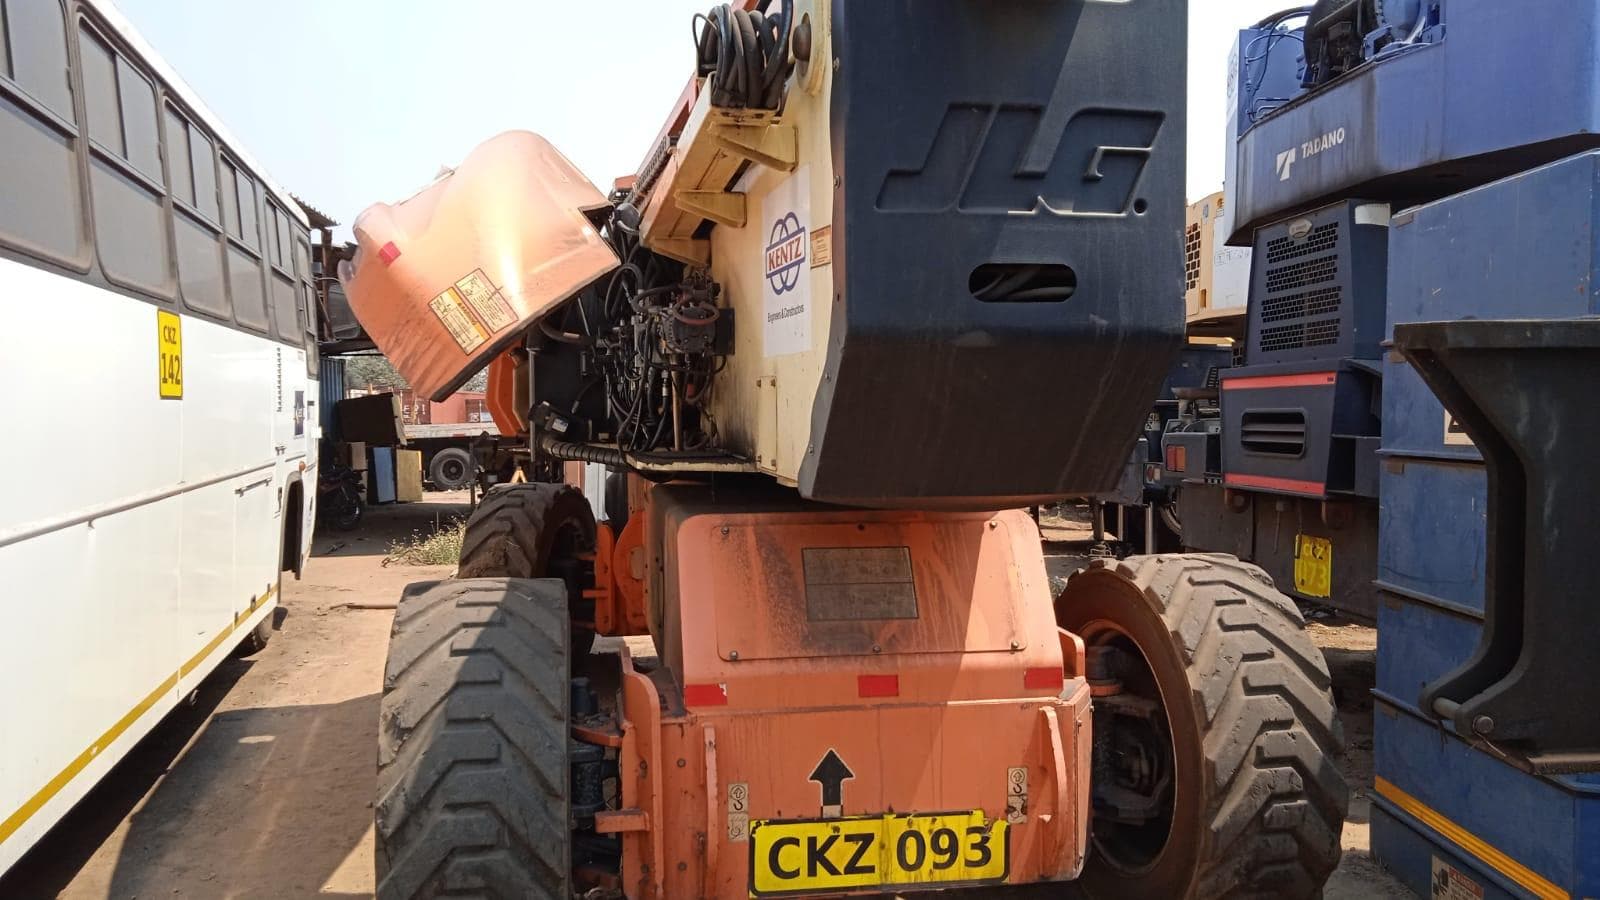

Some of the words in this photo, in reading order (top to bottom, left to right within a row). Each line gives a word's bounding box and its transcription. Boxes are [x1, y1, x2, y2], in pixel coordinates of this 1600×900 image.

[1301, 127, 1345, 159] TADANO
[768, 236, 802, 271] KENTZ
[163, 325, 177, 345] CKZ
[161, 352, 181, 385] 142
[768, 832, 875, 879] CKZ
[896, 826, 992, 872] 093
